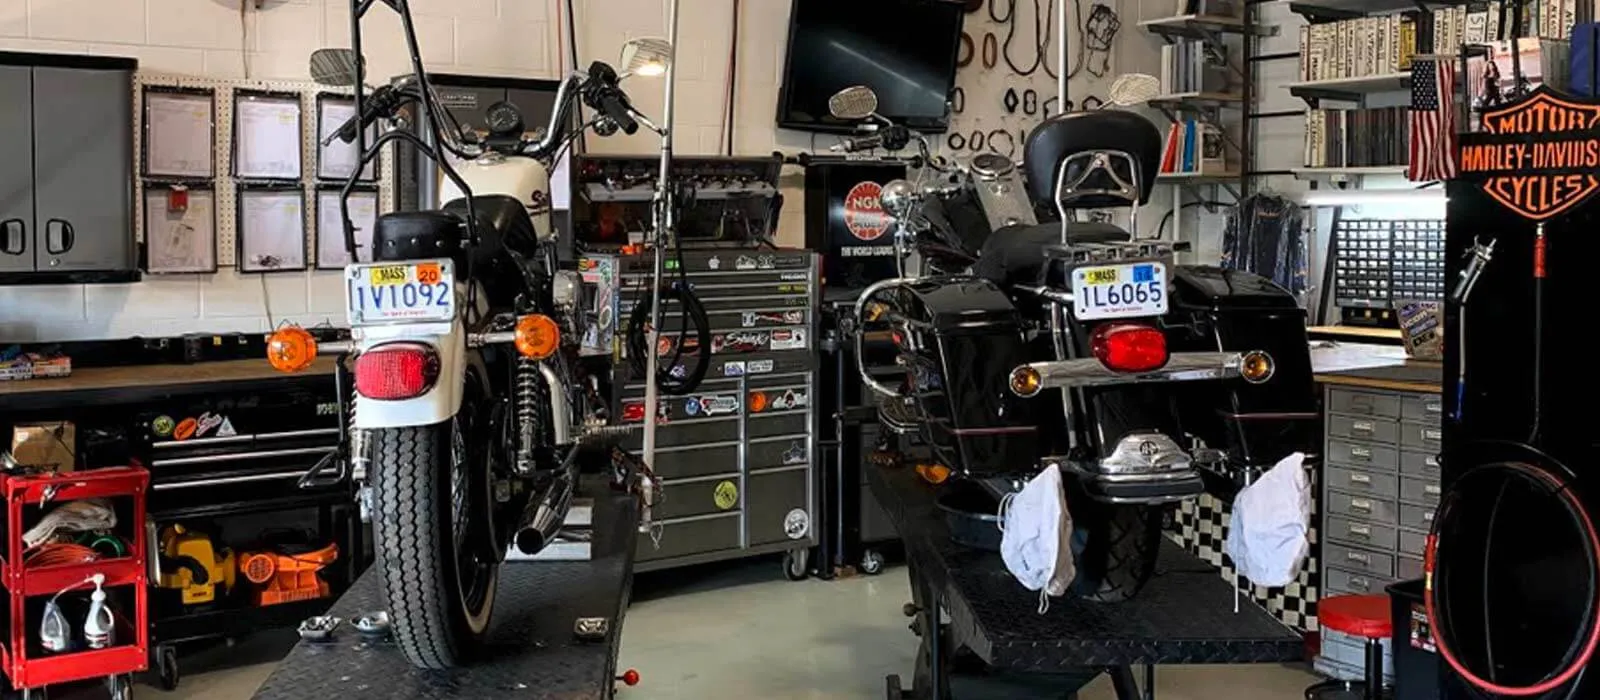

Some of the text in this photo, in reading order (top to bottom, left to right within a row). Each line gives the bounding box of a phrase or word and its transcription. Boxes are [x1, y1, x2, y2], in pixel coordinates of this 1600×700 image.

[1499, 101, 1585, 134] MOTOR
[1461, 138, 1600, 172] HARLEY-DAVIDS
[853, 196, 882, 210] NGK
[1496, 175, 1583, 212] CYCLES
[380, 267, 406, 281] MASS
[419, 270, 438, 282] 20
[1094, 269, 1116, 282] MASS
[357, 281, 449, 310] 1V1092
[1082, 281, 1162, 308] 1L6065
